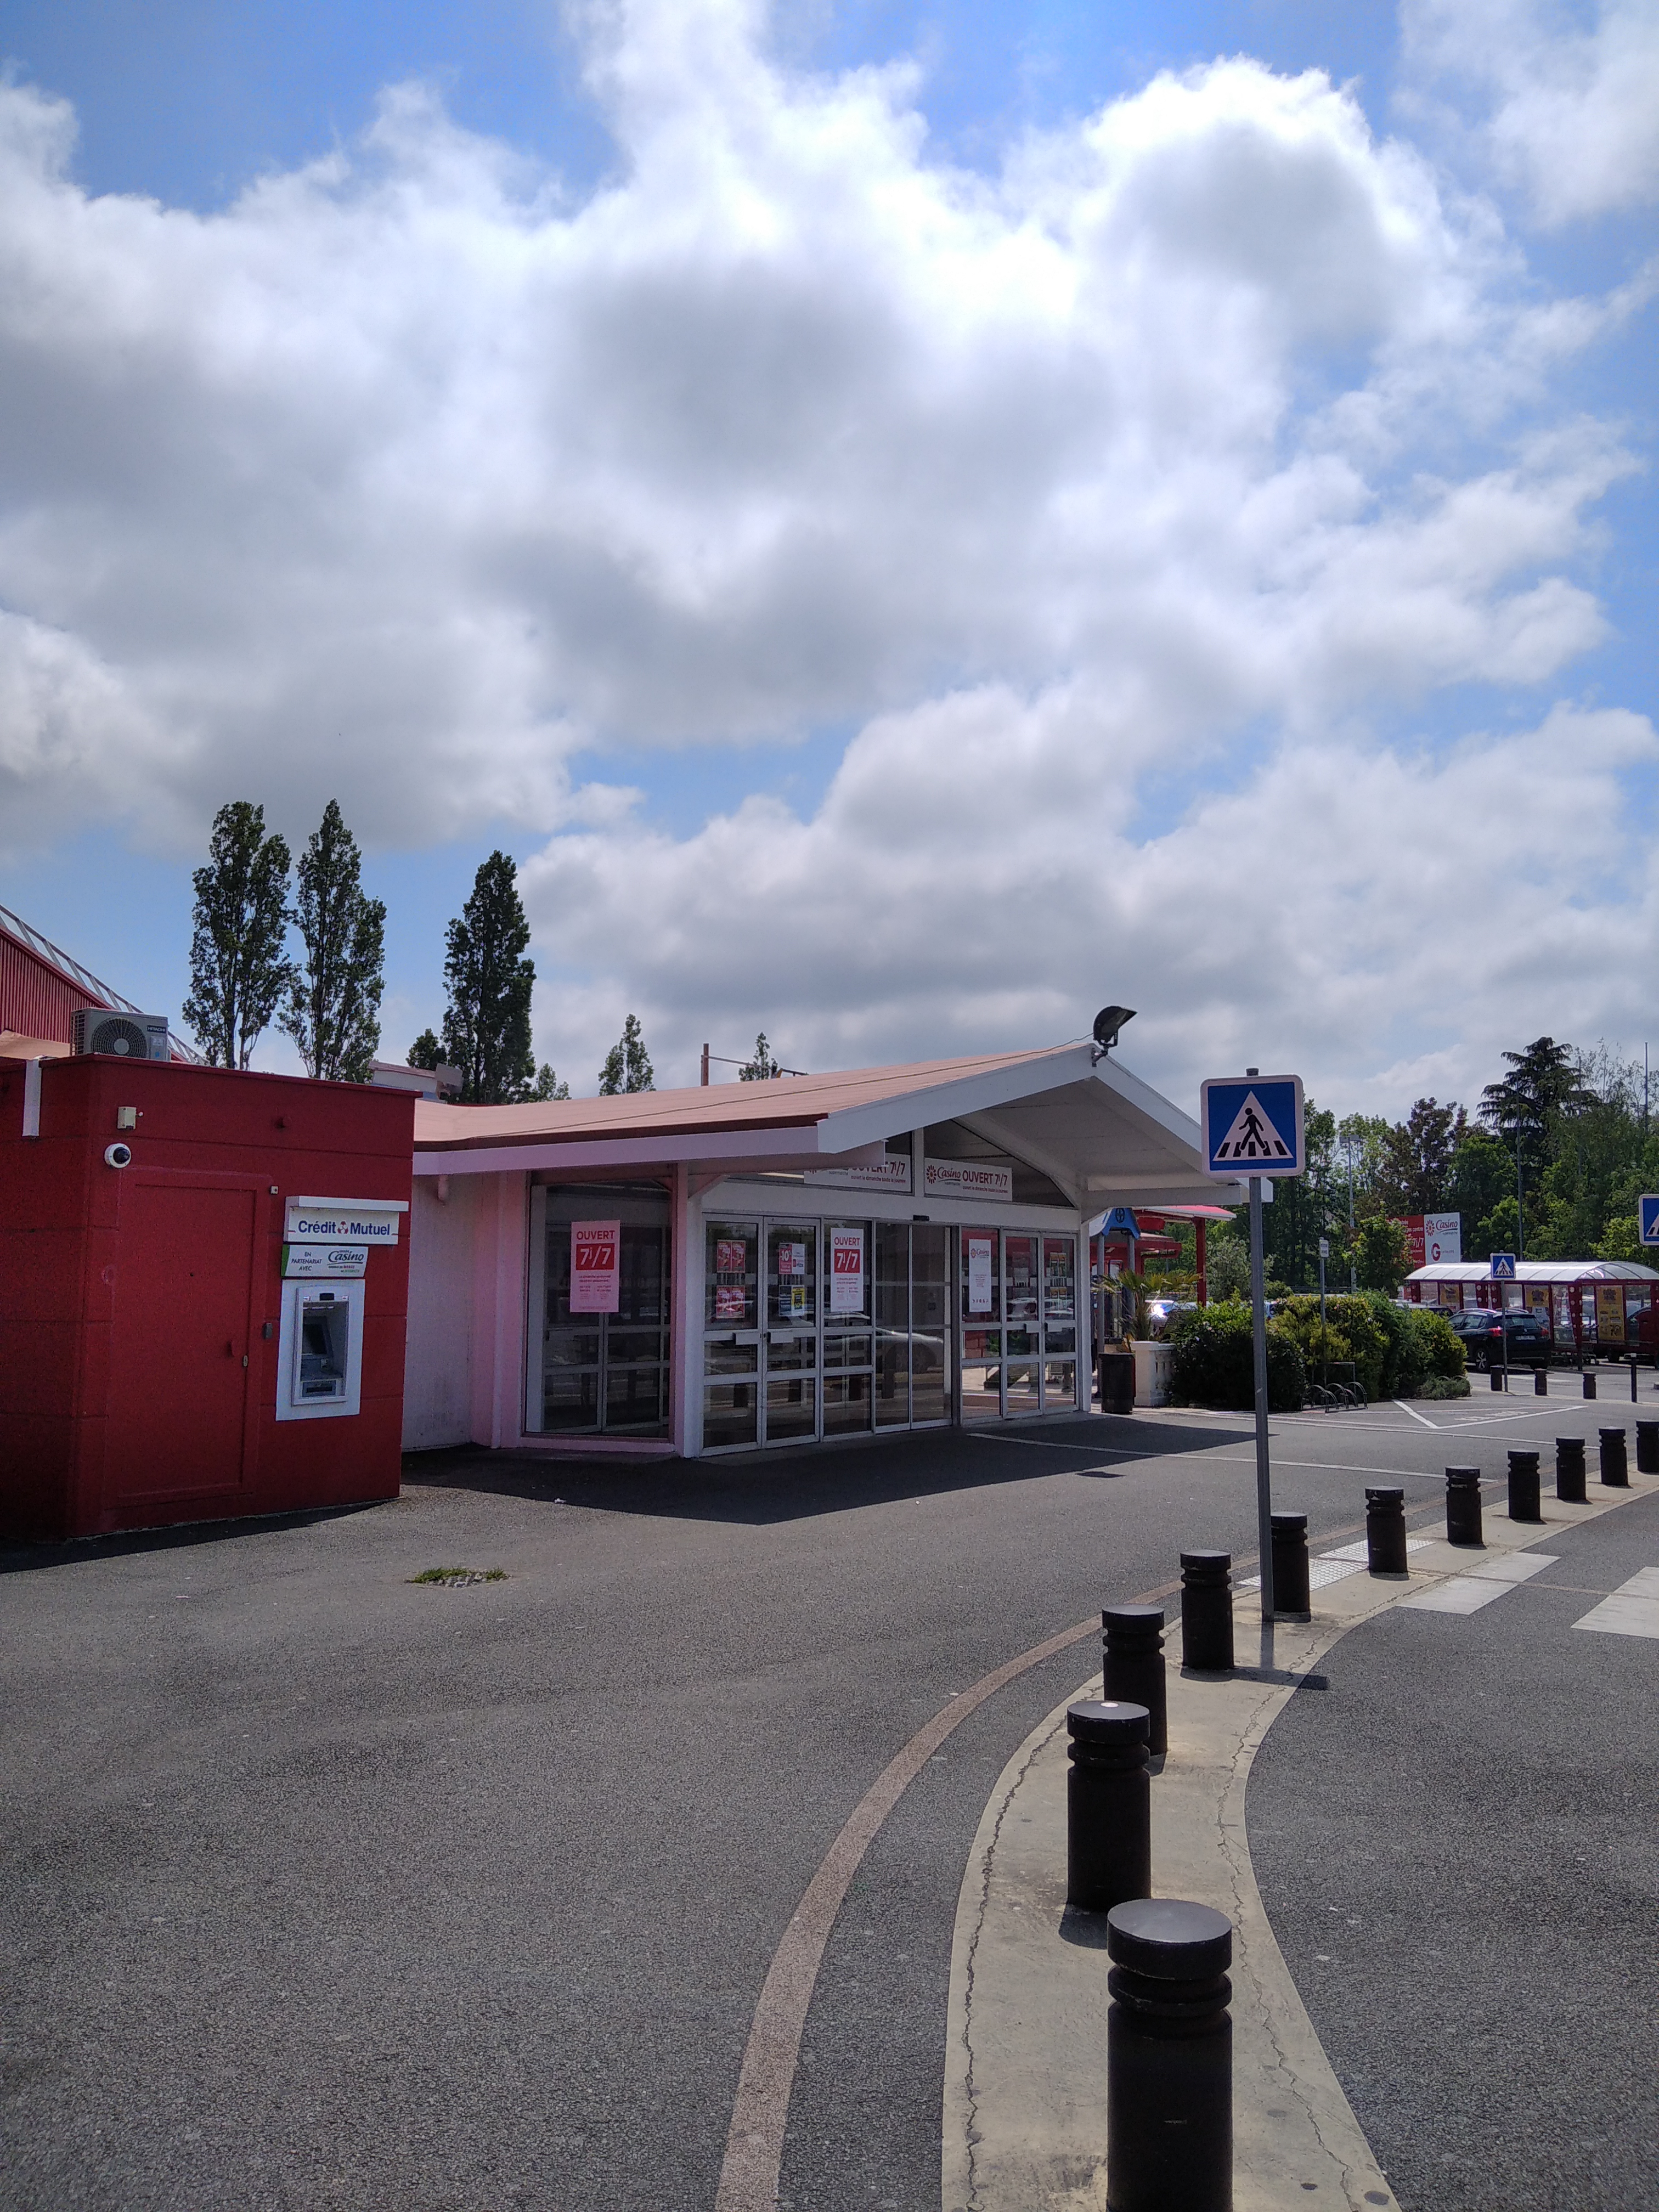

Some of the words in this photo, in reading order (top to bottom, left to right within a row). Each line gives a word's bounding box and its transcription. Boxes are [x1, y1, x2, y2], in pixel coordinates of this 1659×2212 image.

[937, 1167, 961, 1179] Casino
[962, 1170, 993, 1184] OUVERT
[298, 1220, 336, 1234] Crédit
[350, 1222, 390, 1235] Mutuel
[1436, 1219, 1458, 1231] Casino
[577, 1230, 615, 1240] OUVERT
[834, 1237, 860, 1246] OUVERT
[328, 1251, 364, 1262] Casino
[580, 1245, 611, 1268] 7j/7
[1431, 1243, 1441, 1261] G
